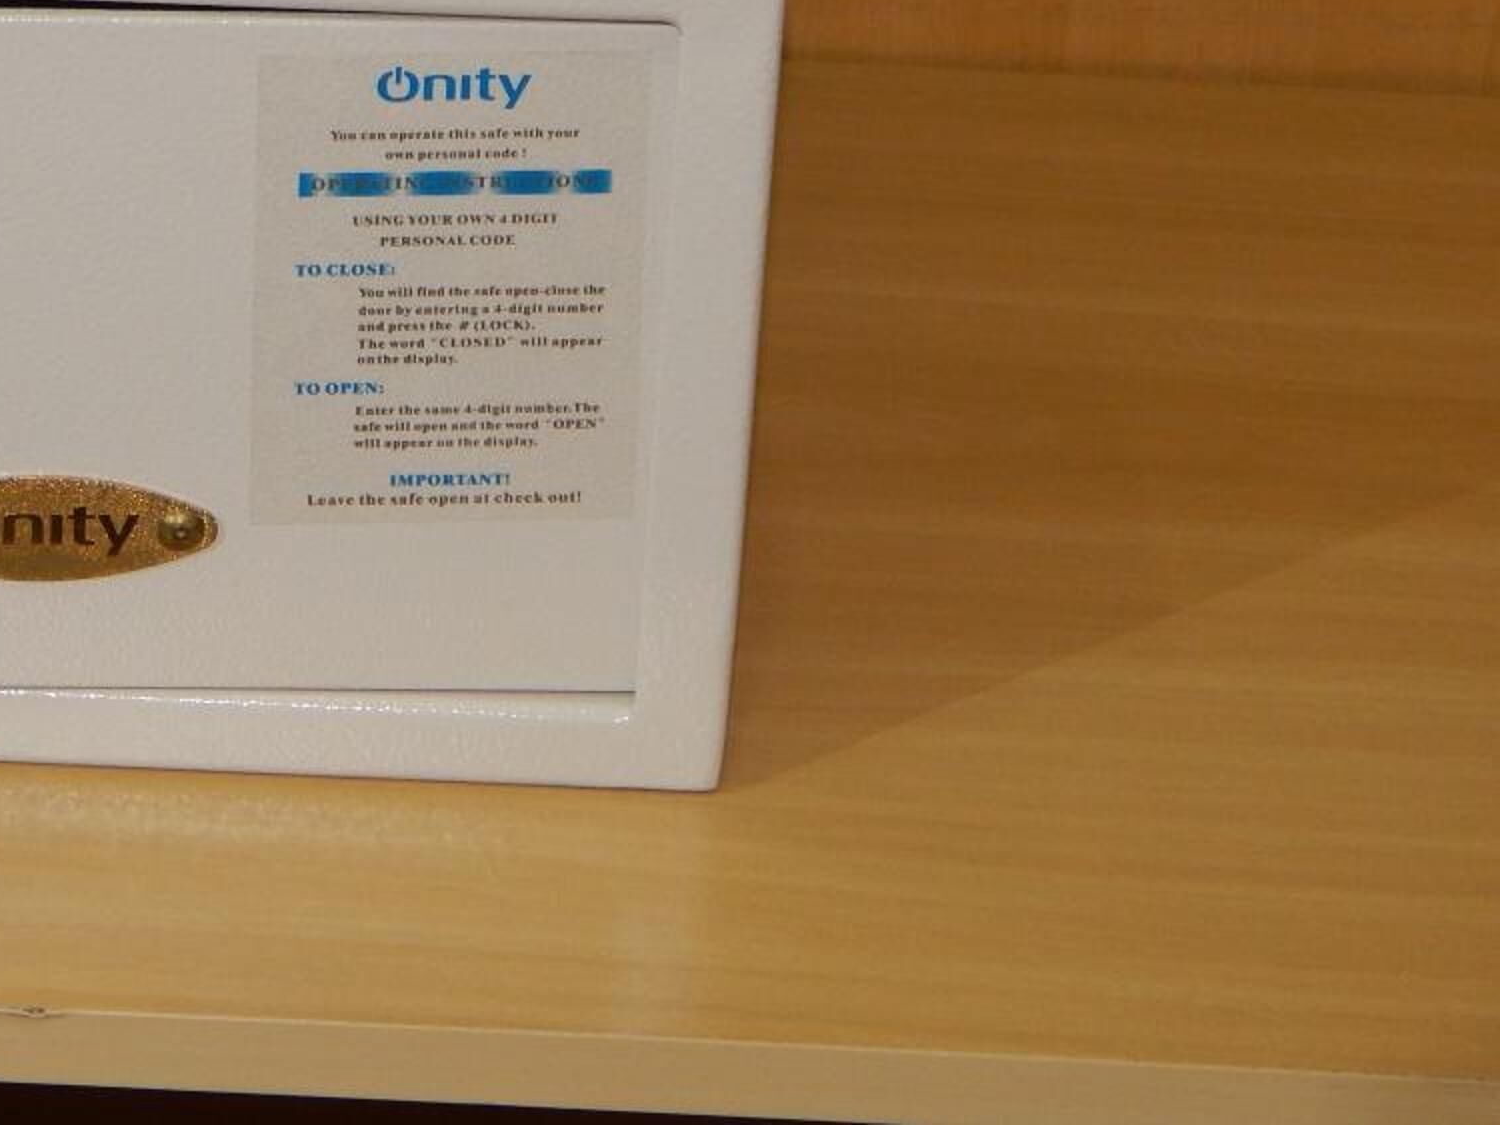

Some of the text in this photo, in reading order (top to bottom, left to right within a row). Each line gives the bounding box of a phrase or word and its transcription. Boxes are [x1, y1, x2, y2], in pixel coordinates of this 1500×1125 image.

[331, 130, 357, 142] You
[390, 129, 444, 142] operate
[449, 128, 476, 139] this
[514, 128, 543, 139] with
[418, 149, 481, 161] personal
[485, 148, 518, 159] code
[353, 215, 403, 226] USING
[407, 214, 453, 226] YOUR
[457, 214, 495, 225] OWN
[512, 213, 557, 225] DIGIT
[380, 235, 516, 247] PERSONAL CODE
[295, 263, 395, 276] TO CLOSE:
[359, 288, 384, 297] You
[388, 287, 413, 297] will
[417, 287, 444, 297] find
[359, 305, 391, 316] door
[396, 305, 411, 317] by
[415, 304, 478, 316] entering
[547, 303, 604, 313] number
[358, 322, 384, 332] and
[388, 324, 426, 334] press
[359, 338, 385, 349] The
[390, 338, 425, 349] word
[520, 337, 547, 347] will
[552, 337, 602, 348] appear
[294, 382, 385, 395] TO OPEN:
[355, 405, 394, 416] Enter
[384, 422, 411, 431] will
[414, 423, 447, 433] open
[506, 420, 539, 430] word
[354, 439, 380, 449] will
[384, 440, 432, 451] appear
[307, 494, 354, 506] Leave
[359, 493, 385, 505] the
[389, 492, 424, 505] safe
[428, 495, 470, 508] open
[495, 492, 543, 504] check
